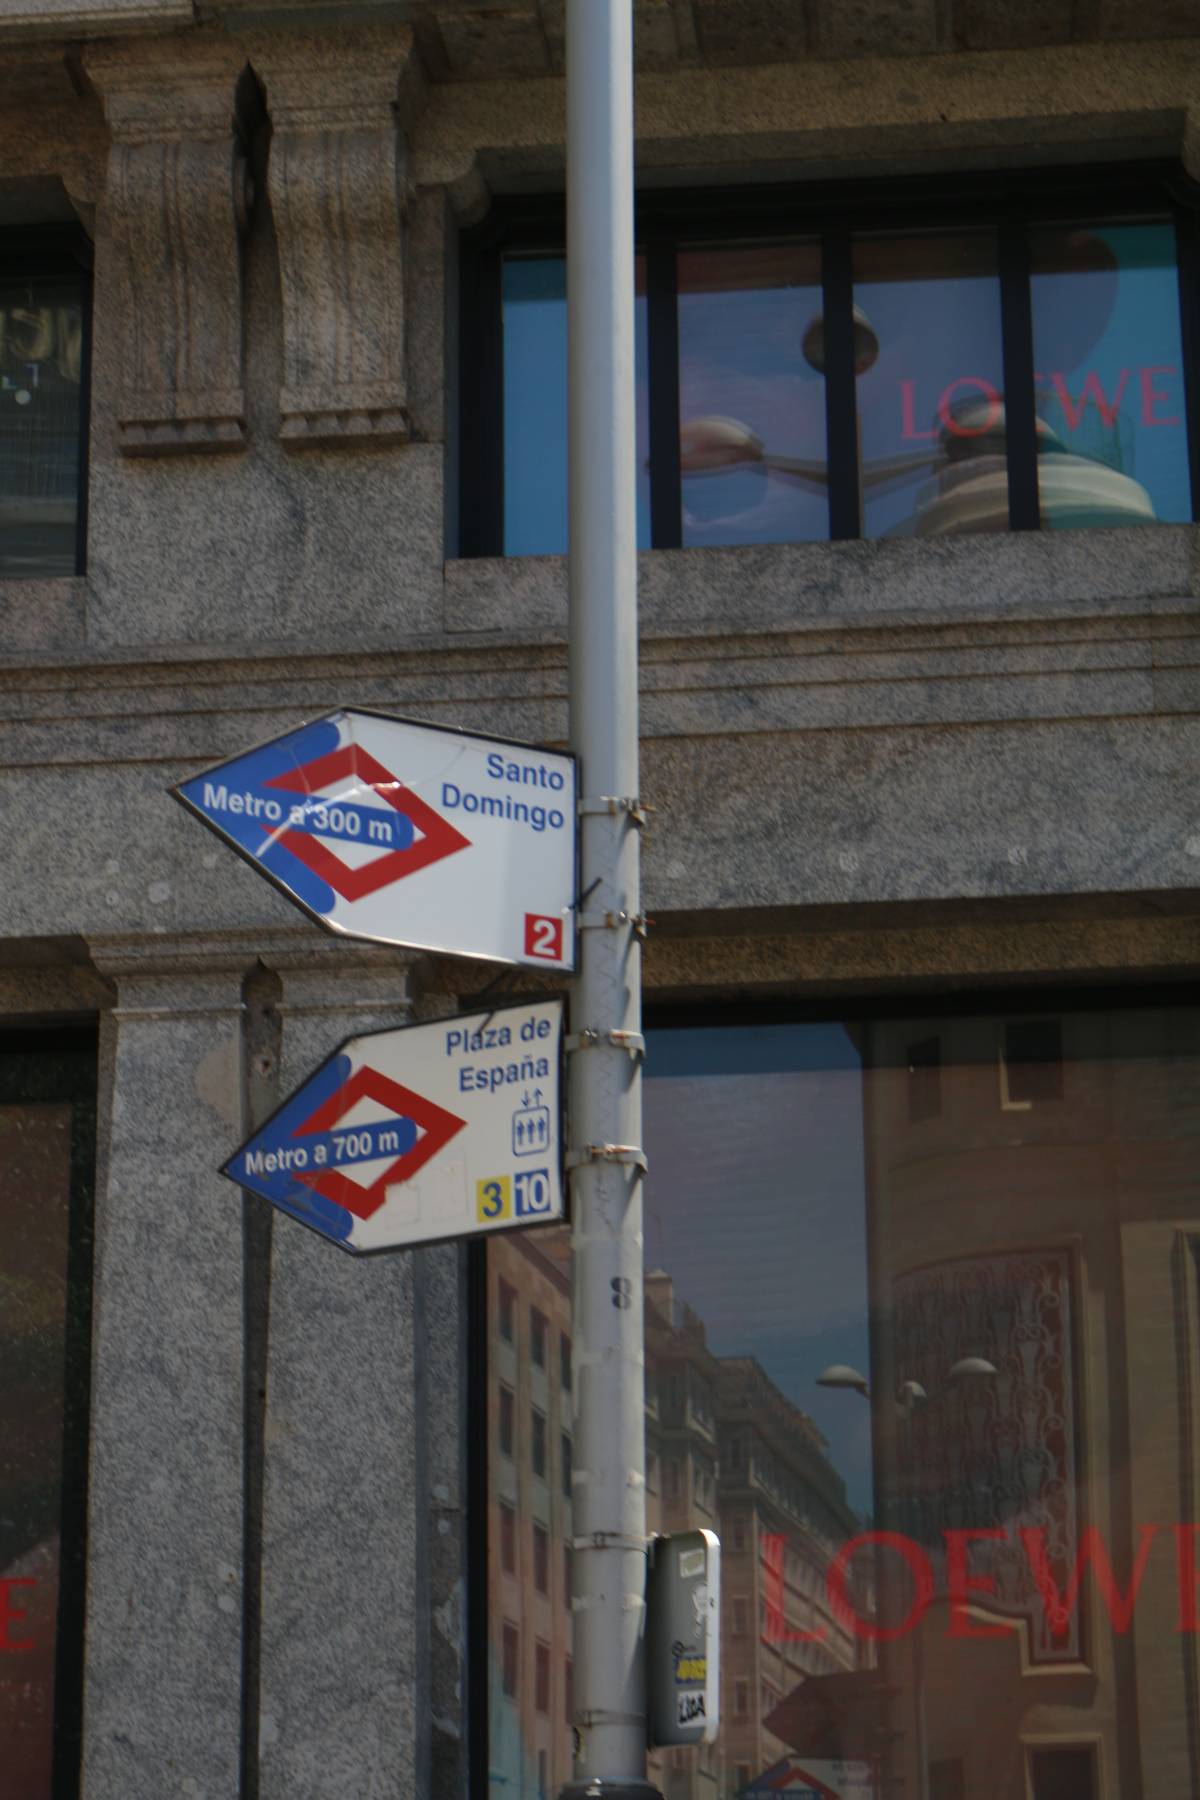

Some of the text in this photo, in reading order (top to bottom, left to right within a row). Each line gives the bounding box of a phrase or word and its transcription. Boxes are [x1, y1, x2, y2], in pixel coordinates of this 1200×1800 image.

[900, 367, 1182, 440] LOWE
[487, 753, 564, 790] Santo
[203, 783, 393, 842] Metro a 300 m
[442, 782, 564, 832] Domingo
[532, 919, 557, 957] 2
[446, 1016, 551, 1057] Plaza de
[459, 1054, 549, 1094] España
[245, 1131, 399, 1175] Metro a 700 m
[482, 1173, 549, 1218] 3 10
